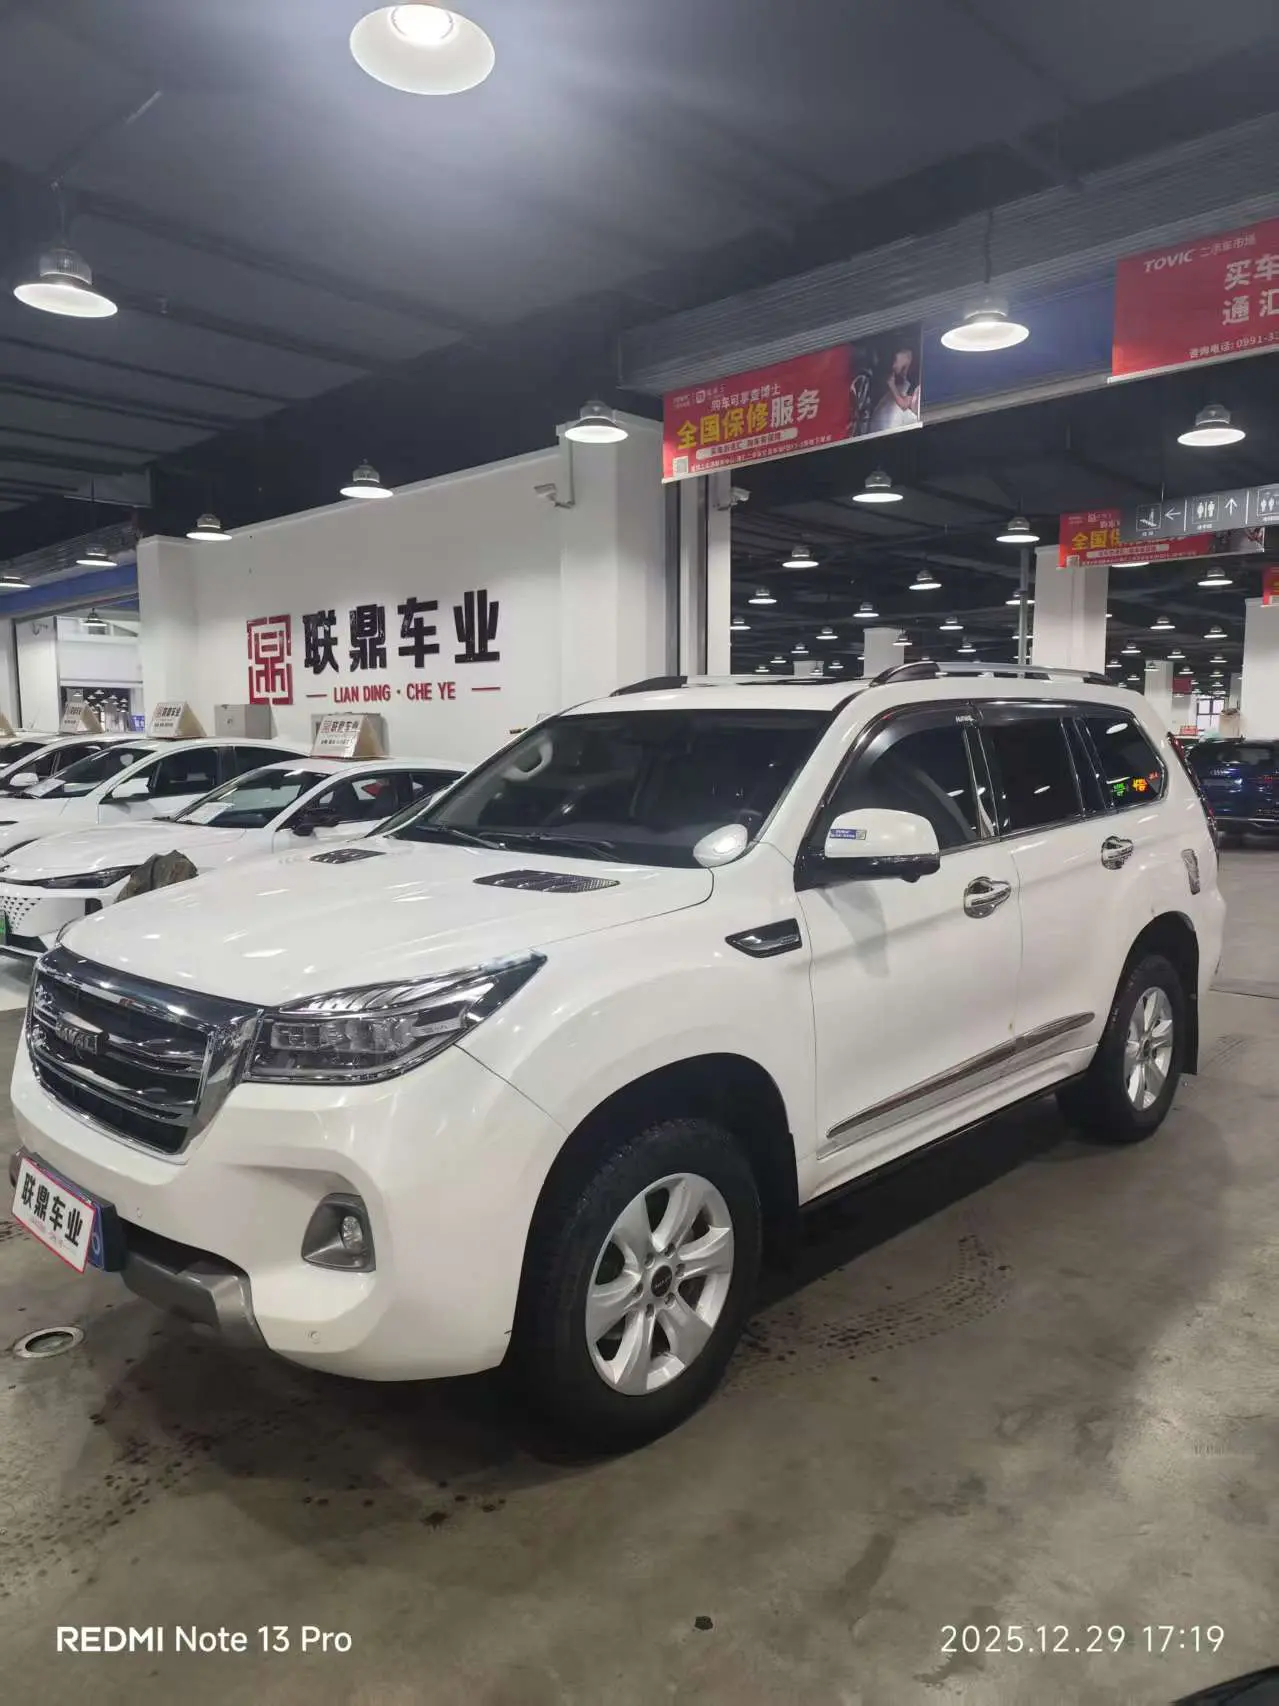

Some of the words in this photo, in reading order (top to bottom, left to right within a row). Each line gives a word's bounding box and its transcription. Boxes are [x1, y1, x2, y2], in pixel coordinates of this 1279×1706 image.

[1144, 249, 1194, 273] TOVIC
[1224, 253, 1279, 290] 买车
[1222, 288, 1279, 326] 通汇
[677, 388, 820, 449] 全国保修服务
[302, 589, 500, 675] 联鼎车业
[333, 685, 359, 703] LIAN
[364, 684, 391, 702] DING
[406, 682, 432, 700] CHE
[438, 681, 456, 700] YE
[21, 1172, 83, 1247] 联鼎车业
